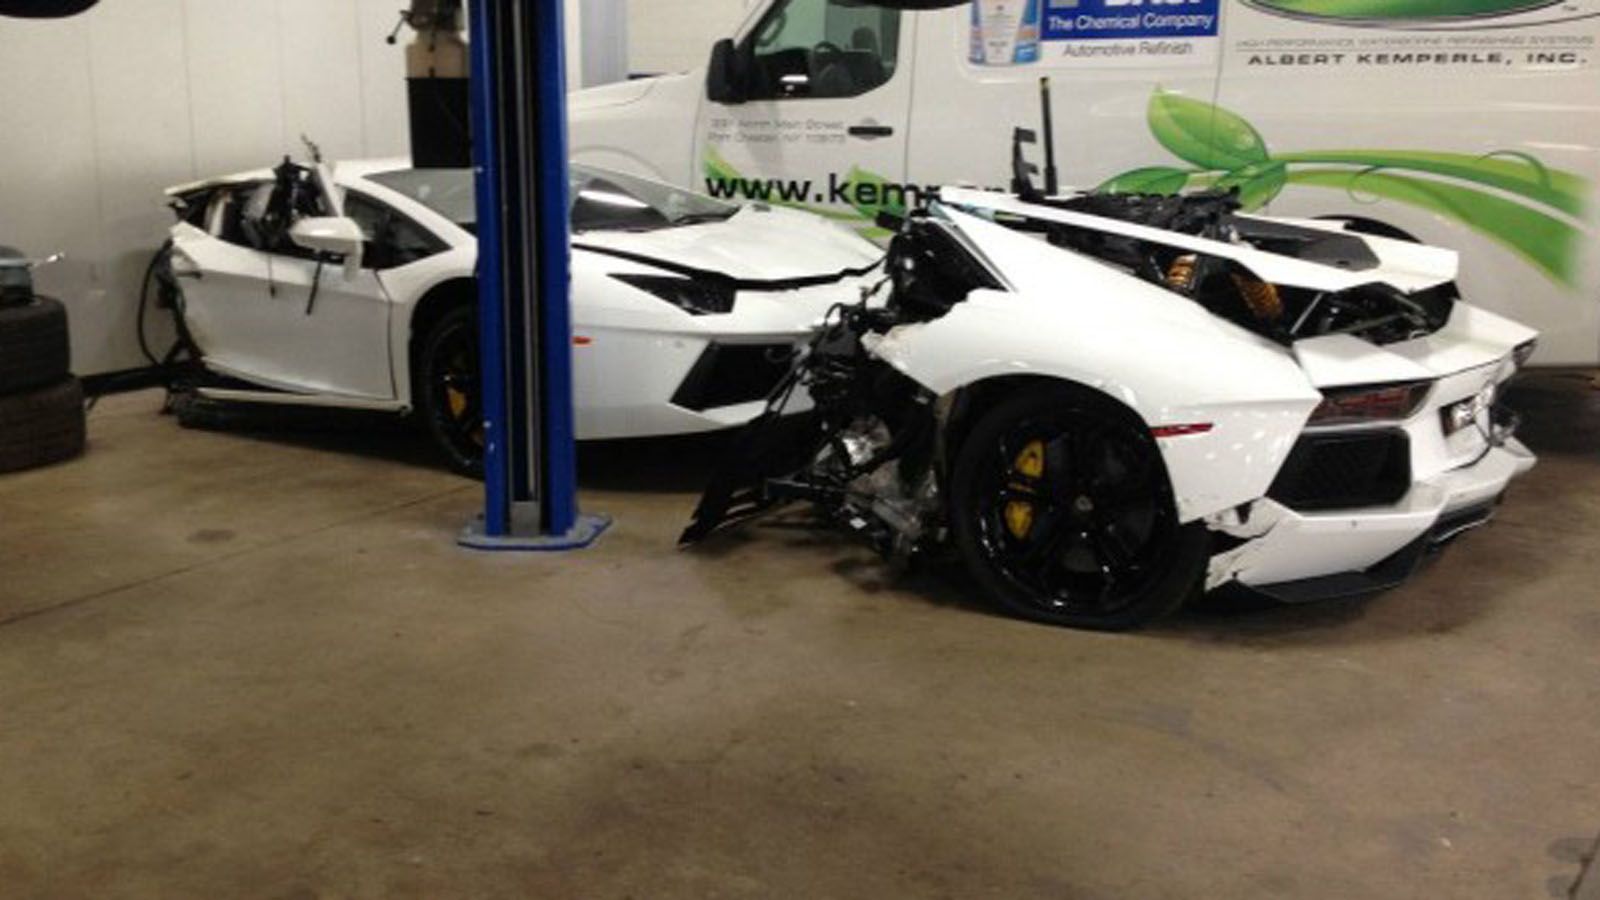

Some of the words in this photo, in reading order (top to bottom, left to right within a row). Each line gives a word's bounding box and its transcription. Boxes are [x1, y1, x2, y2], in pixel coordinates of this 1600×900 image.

[1049, 15, 1074, 30] The
[1075, 14, 1141, 30] Chemical
[1143, 12, 1213, 30] Company
[1063, 43, 1136, 58] Automotive
[1138, 41, 1193, 56] Refinish
[1248, 53, 1345, 66] ALBERT
[1357, 53, 1513, 66] KEMPERLE,
[1526, 52, 1588, 64] INC.
